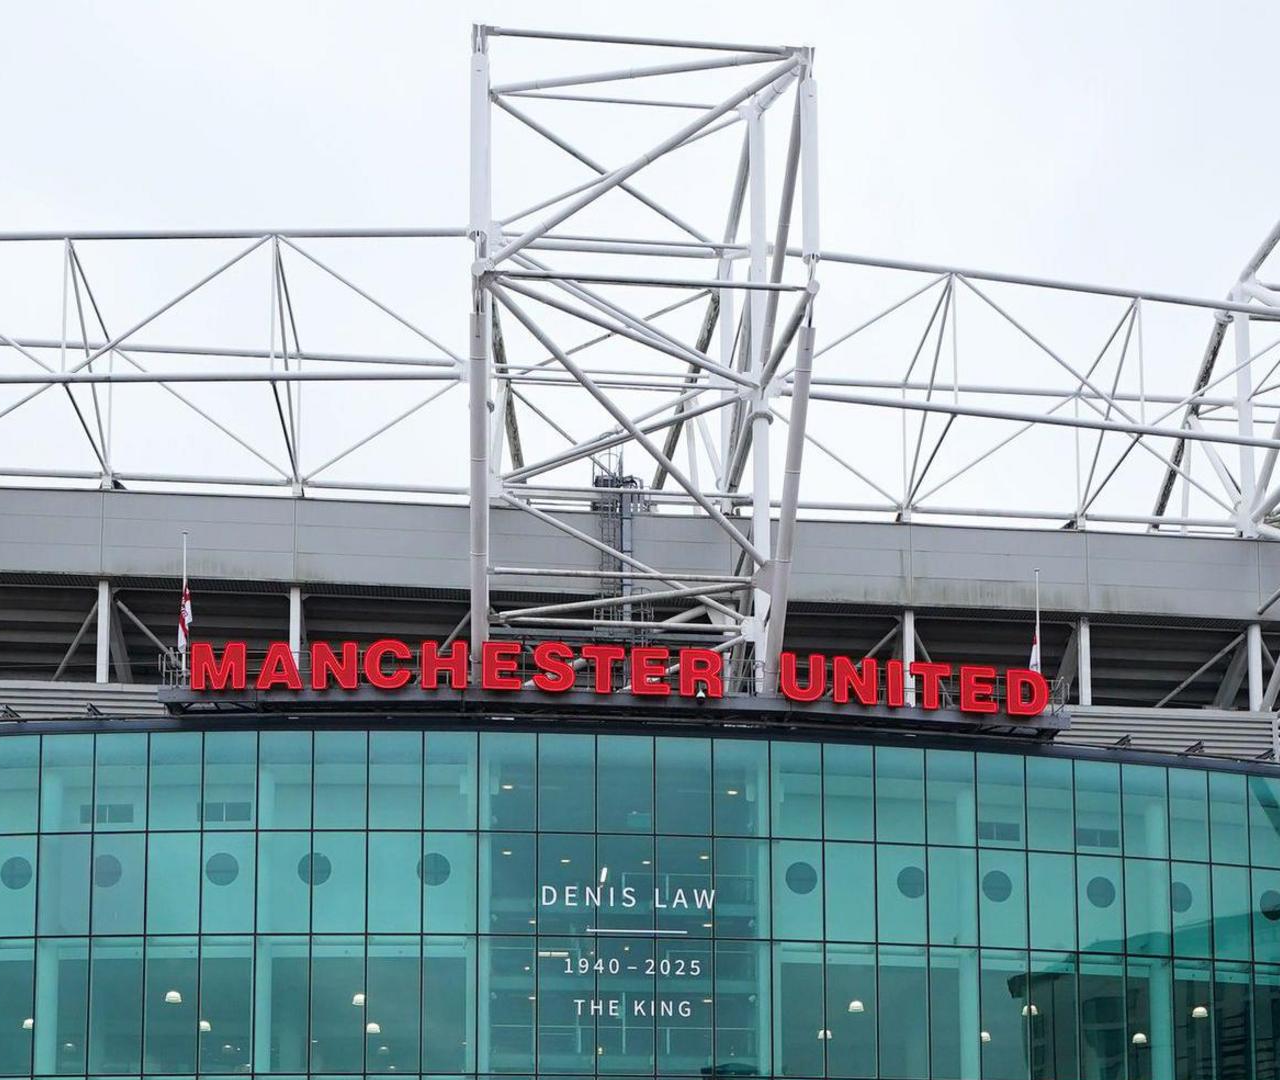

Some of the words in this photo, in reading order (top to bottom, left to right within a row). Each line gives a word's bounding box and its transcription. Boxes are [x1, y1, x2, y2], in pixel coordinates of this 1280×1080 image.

[189, 639, 724, 699] MANCHESTER
[779, 651, 1051, 716] UNITED
[540, 883, 638, 908] DENIS
[653, 886, 718, 909] LAW
[574, 999, 624, 1017] THE
[633, 999, 693, 1017] KING
